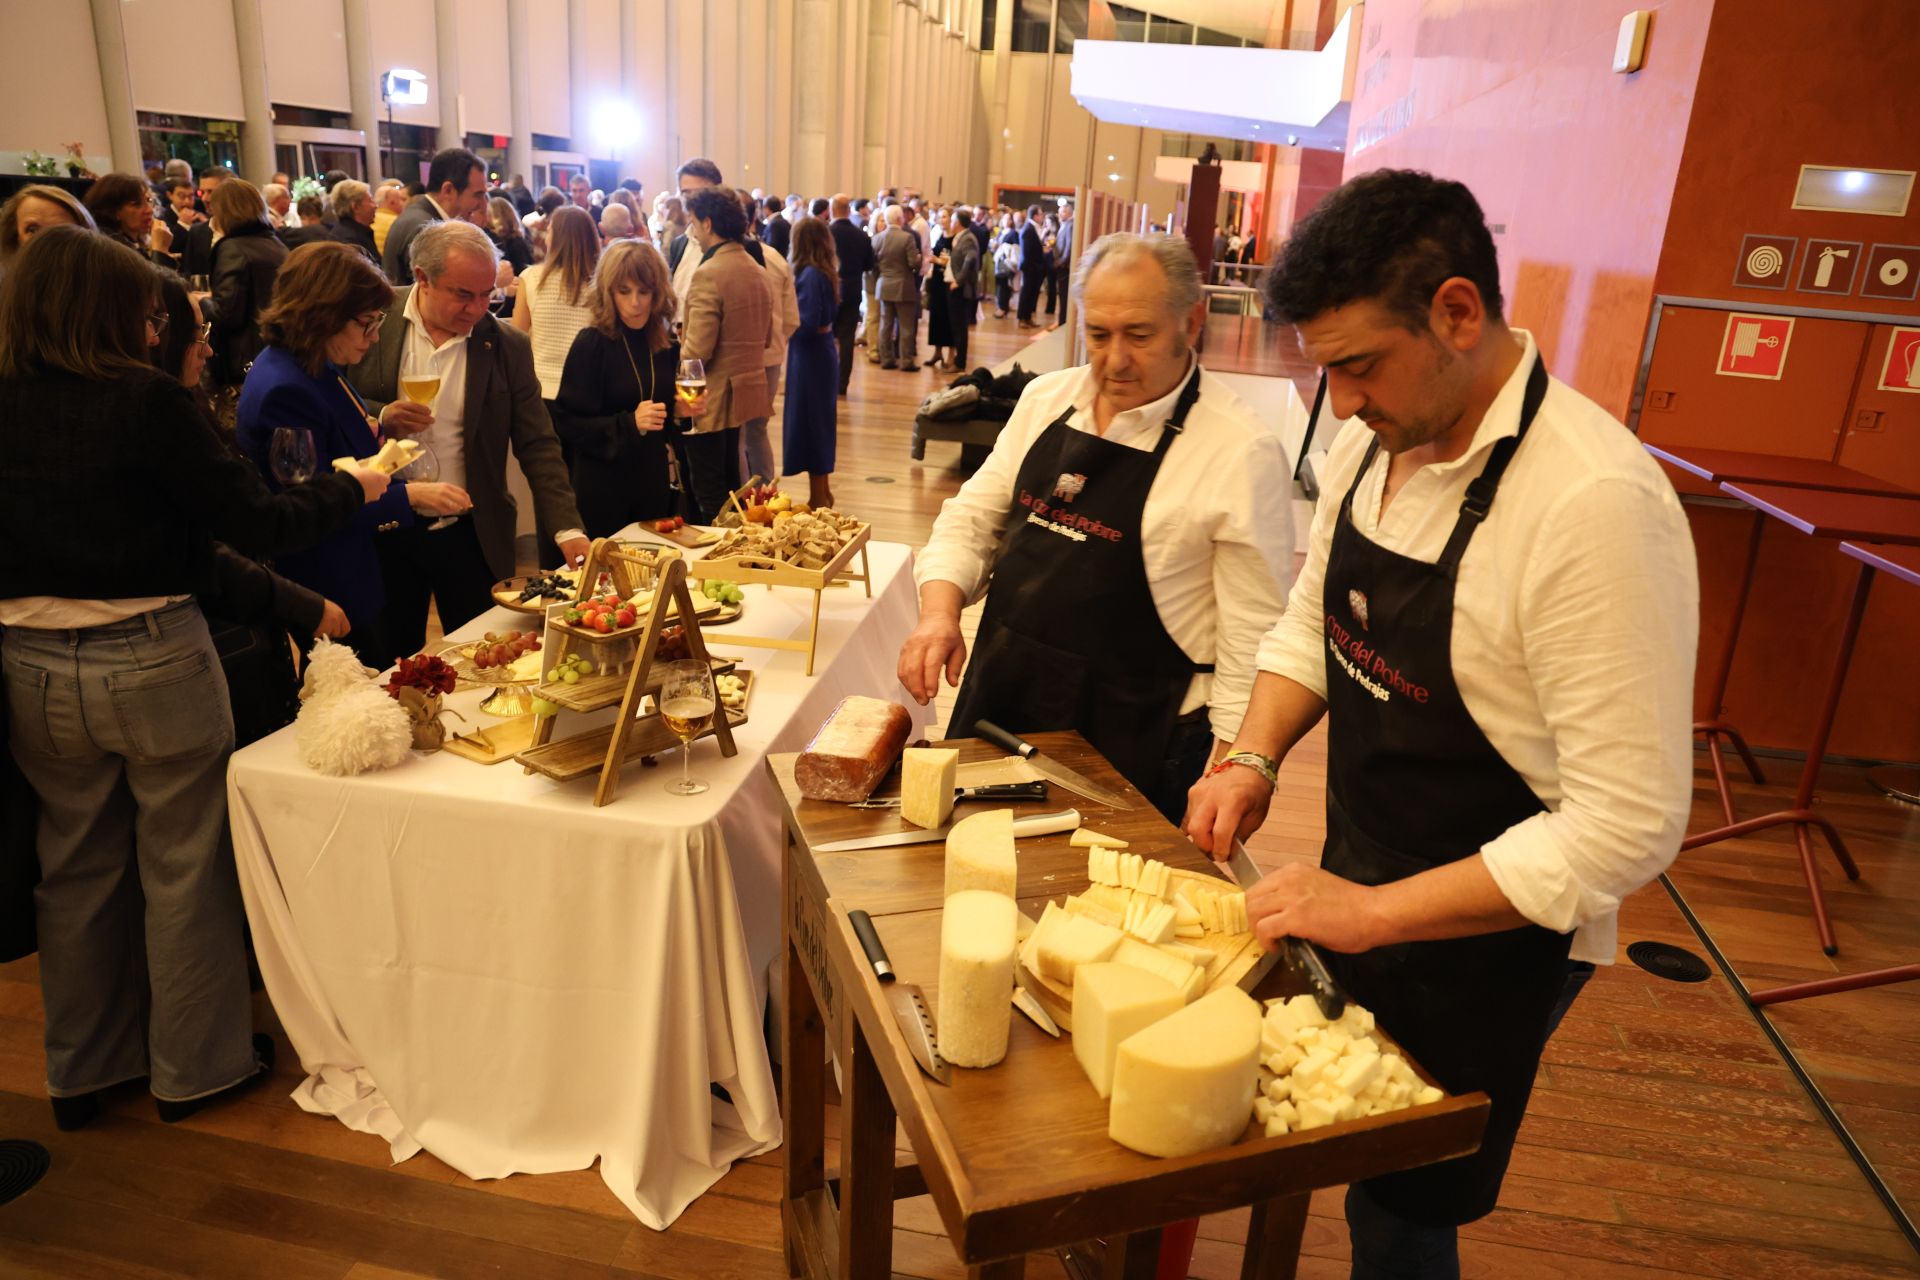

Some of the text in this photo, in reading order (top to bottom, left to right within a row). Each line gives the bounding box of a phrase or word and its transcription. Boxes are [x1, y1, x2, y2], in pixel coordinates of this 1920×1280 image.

[1349, 641, 1375, 668] del
[1373, 656, 1429, 703] Pobre
[1355, 668, 1390, 702] Pedrajas
